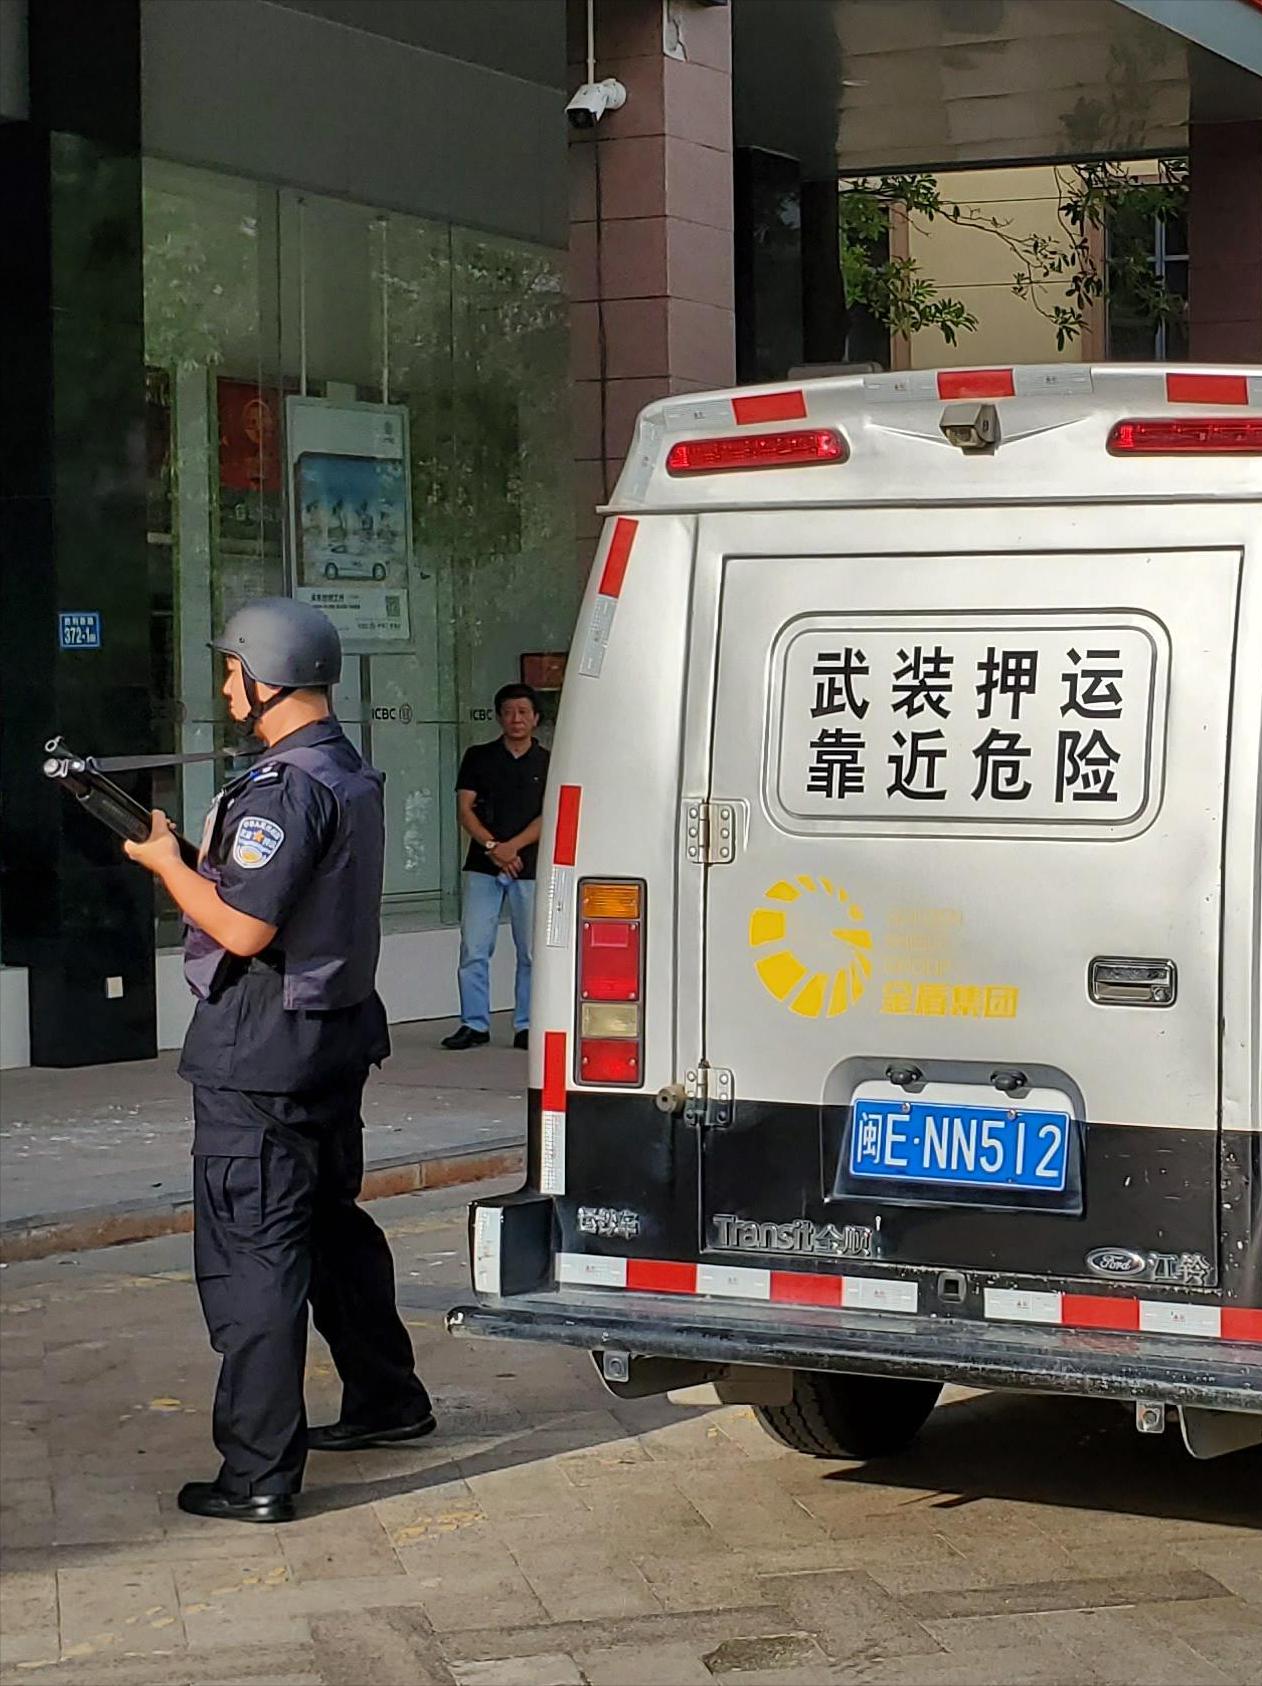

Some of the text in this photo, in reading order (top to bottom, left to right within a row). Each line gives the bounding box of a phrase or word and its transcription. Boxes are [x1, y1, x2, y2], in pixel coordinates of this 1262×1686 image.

[810, 646, 1123, 720] 武装押运
[371, 708, 396, 720] ICBC
[470, 709, 493, 721] ICBC
[806, 728, 1121, 803] 靠近危险
[881, 980, 1019, 1018] 金盾集团
[1148, 1252, 1210, 1285] 江铃
